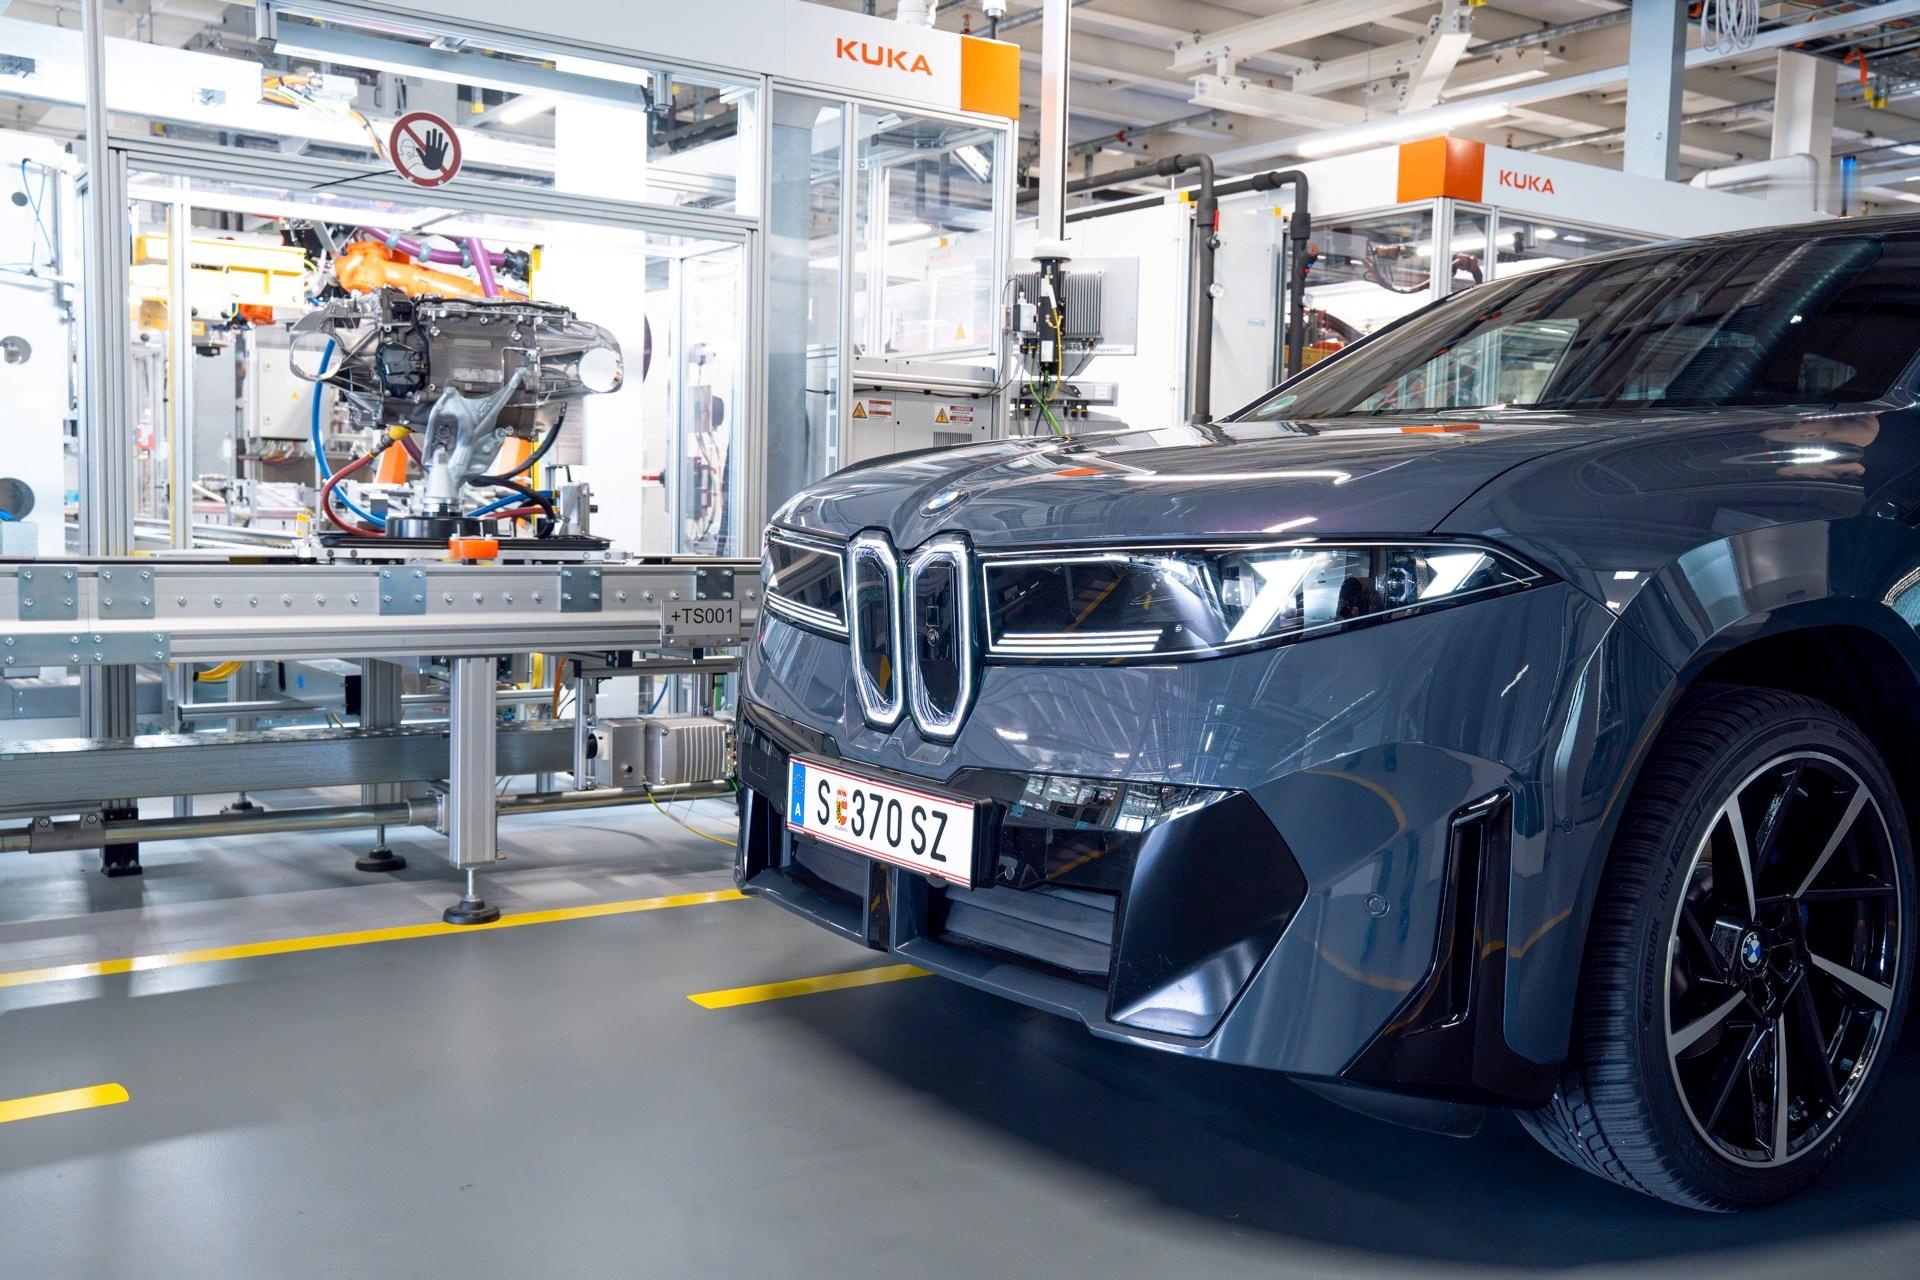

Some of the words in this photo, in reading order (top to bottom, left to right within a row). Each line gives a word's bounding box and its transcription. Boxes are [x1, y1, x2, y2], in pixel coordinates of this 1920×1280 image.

[836, 37, 933, 76] KUKA
[1499, 169, 1555, 195] KUKA
[671, 608, 733, 624] +TS001
[794, 802, 801, 817] A
[817, 779, 831, 826] S
[851, 789, 903, 848] 370
[910, 805, 948, 863] SZ
